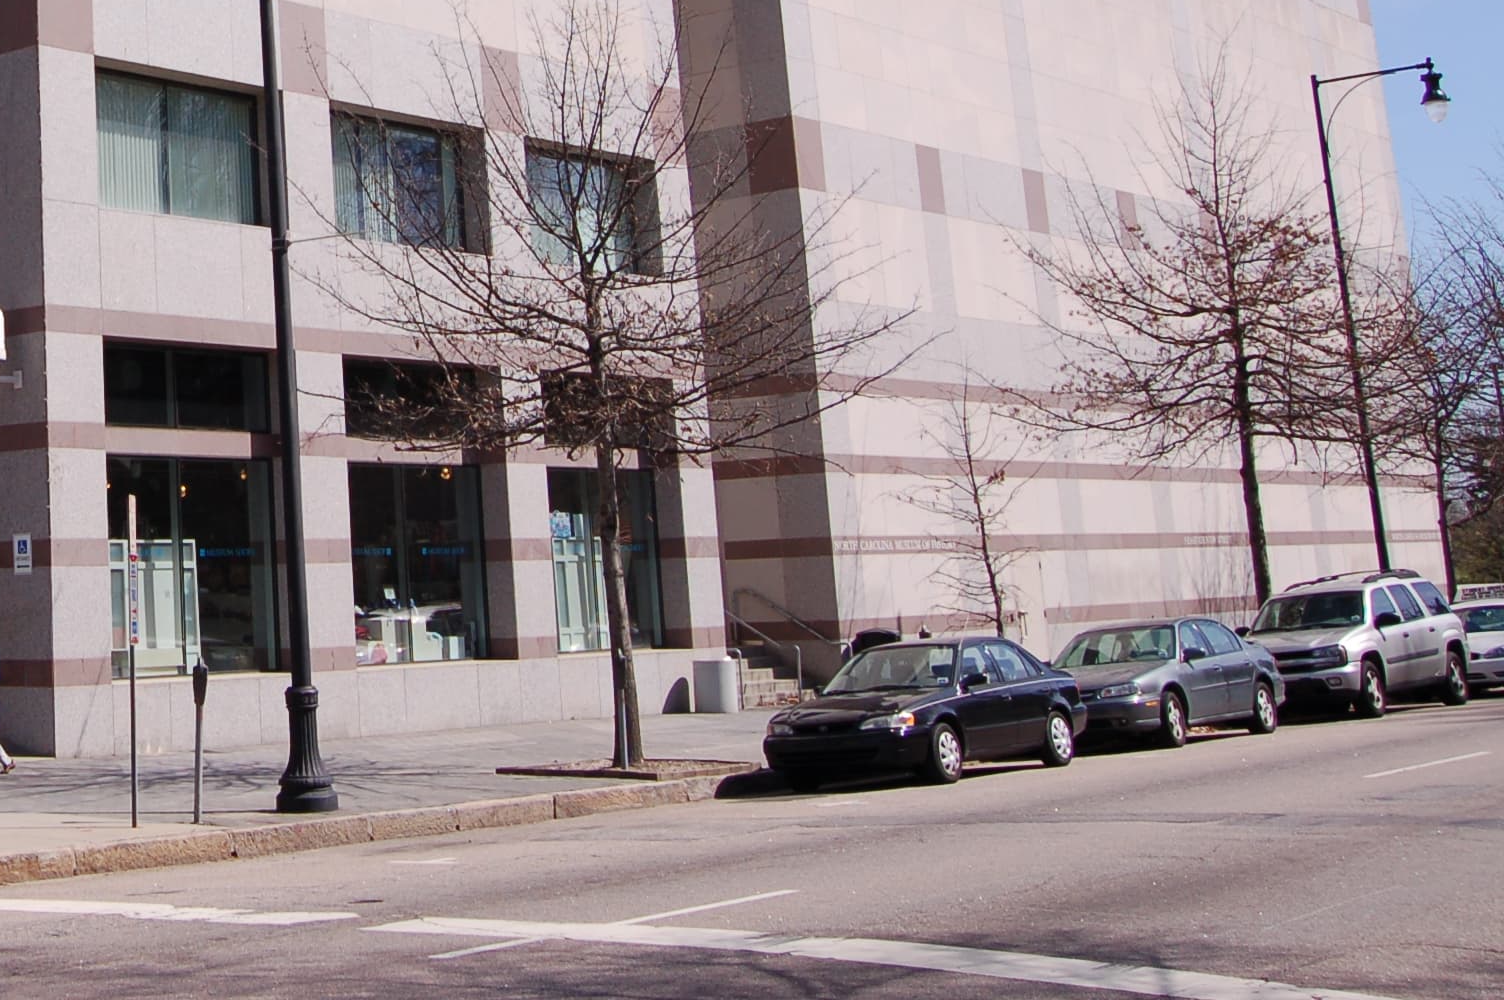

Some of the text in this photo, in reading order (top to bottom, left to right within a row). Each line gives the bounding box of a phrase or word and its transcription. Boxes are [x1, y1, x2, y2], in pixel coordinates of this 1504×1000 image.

[833, 540, 858, 551] NORTH
[860, 540, 894, 550] CAROLINA
[895, 540, 921, 550] MUSEUM
